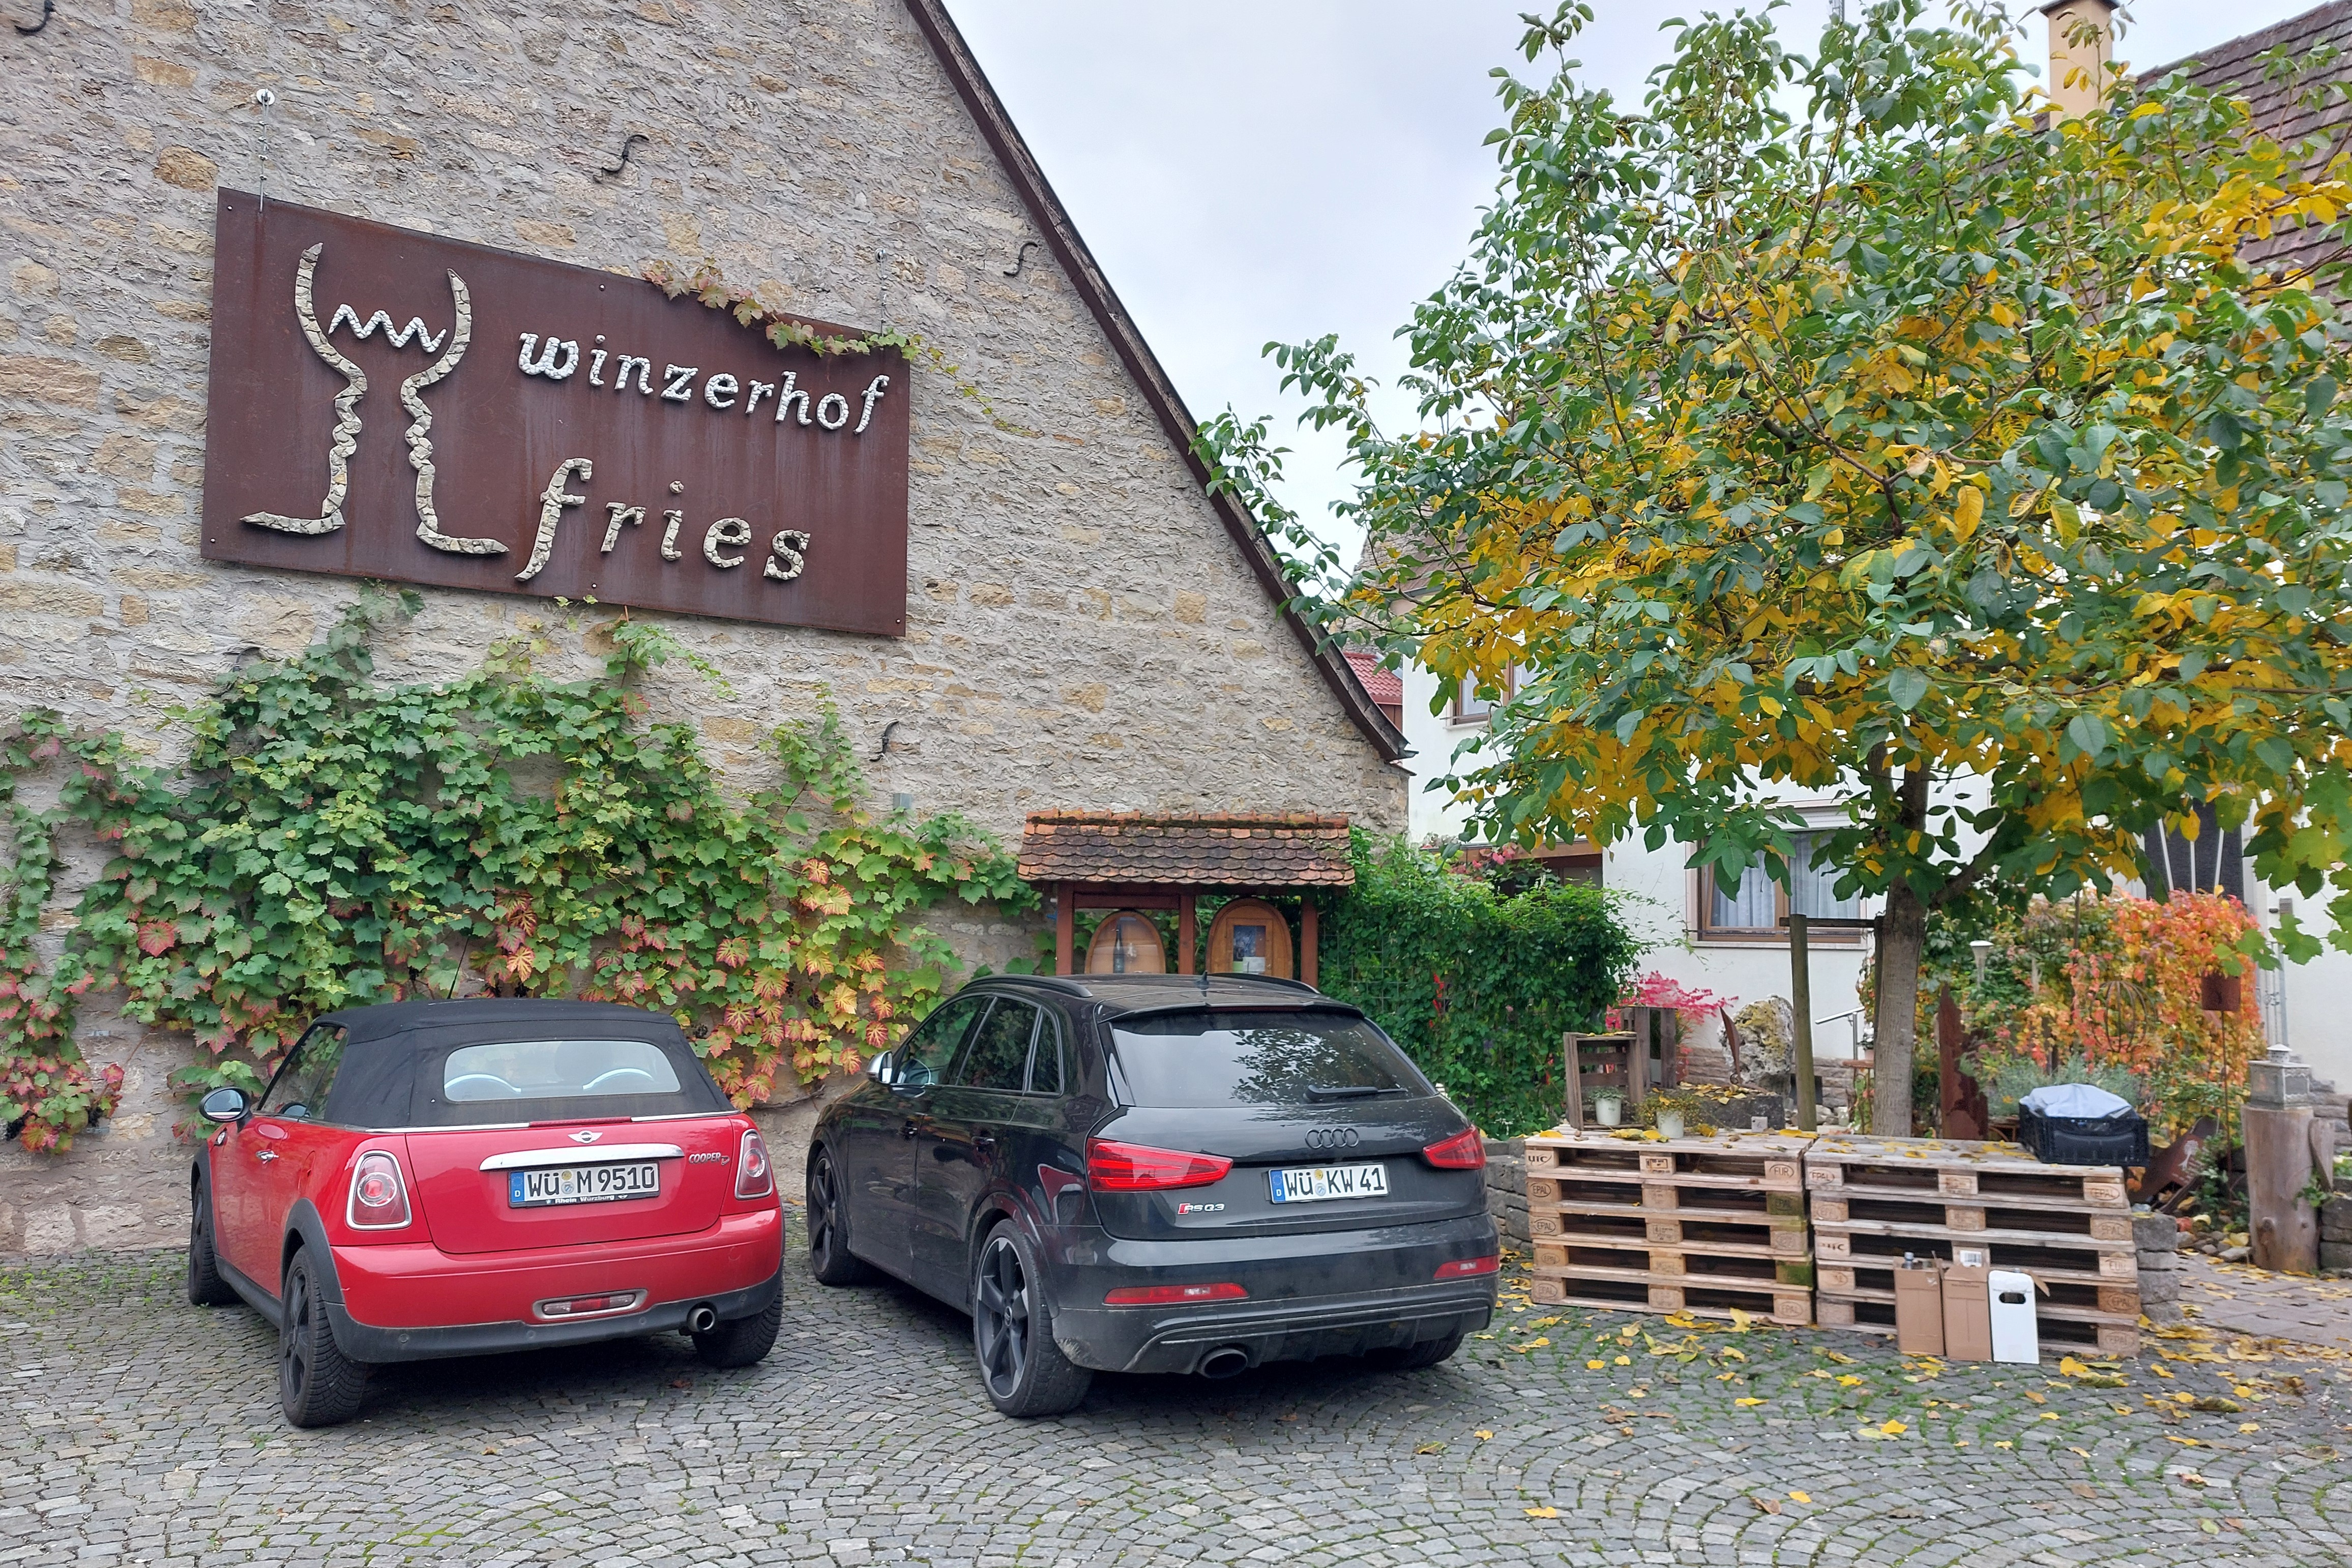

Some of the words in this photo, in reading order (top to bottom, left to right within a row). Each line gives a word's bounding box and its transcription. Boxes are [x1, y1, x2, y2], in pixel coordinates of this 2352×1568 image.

[518, 333, 890, 435] winzerhof
[514, 458, 811, 582] fries
[688, 1152, 721, 1164] COOPER
[527, 1173, 560, 1197] WÜ
[577, 1170, 592, 1194] M
[597, 1166, 654, 1192] 9510
[1284, 1171, 1314, 1196] WÜ
[1326, 1168, 1354, 1194] KW
[1360, 1167, 1385, 1191] 41
